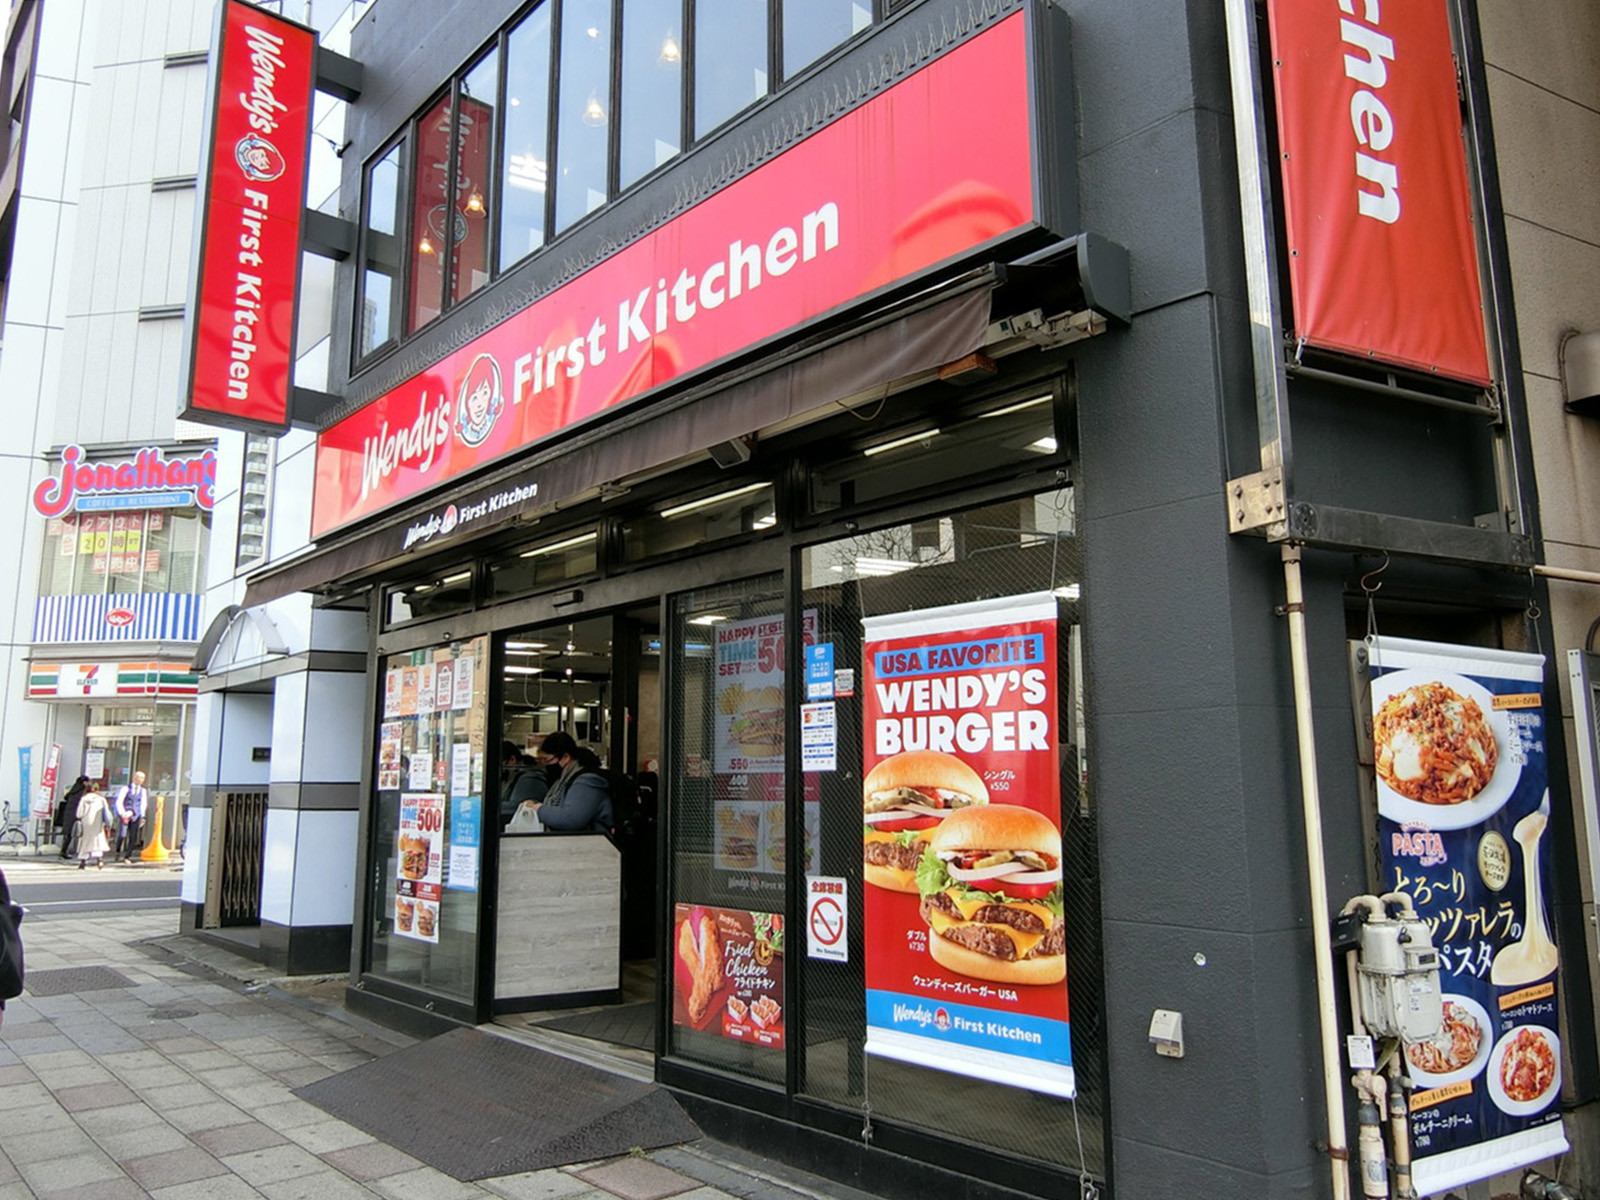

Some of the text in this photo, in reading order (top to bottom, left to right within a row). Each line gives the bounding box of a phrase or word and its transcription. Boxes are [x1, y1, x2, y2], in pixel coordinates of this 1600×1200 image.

[227, 25, 288, 400] Wendy's First Kitchen
[361, 201, 839, 501] Wendy's First Kitchen
[404, 483, 538, 550] Wendy's First Kitchen
[719, 640, 757, 662] TIME
[881, 639, 1035, 674] USA FAVORITE
[718, 662, 741, 677] SET
[875, 668, 1047, 714] WENDY'S
[875, 709, 1050, 756] BURGER
[983, 769, 1016, 781] シングル
[417, 808, 442, 832] 500
[1391, 832, 1446, 858] PASTA
[1421, 901, 1522, 942] ッツァレラの
[725, 940, 755, 957] Fried
[906, 930, 927, 941] ダブル
[725, 956, 768, 977] Chicken
[912, 974, 1018, 1001] ウェンディーズバーガー USA
[893, 1003, 1042, 1044] Wendy's First Kitchen
